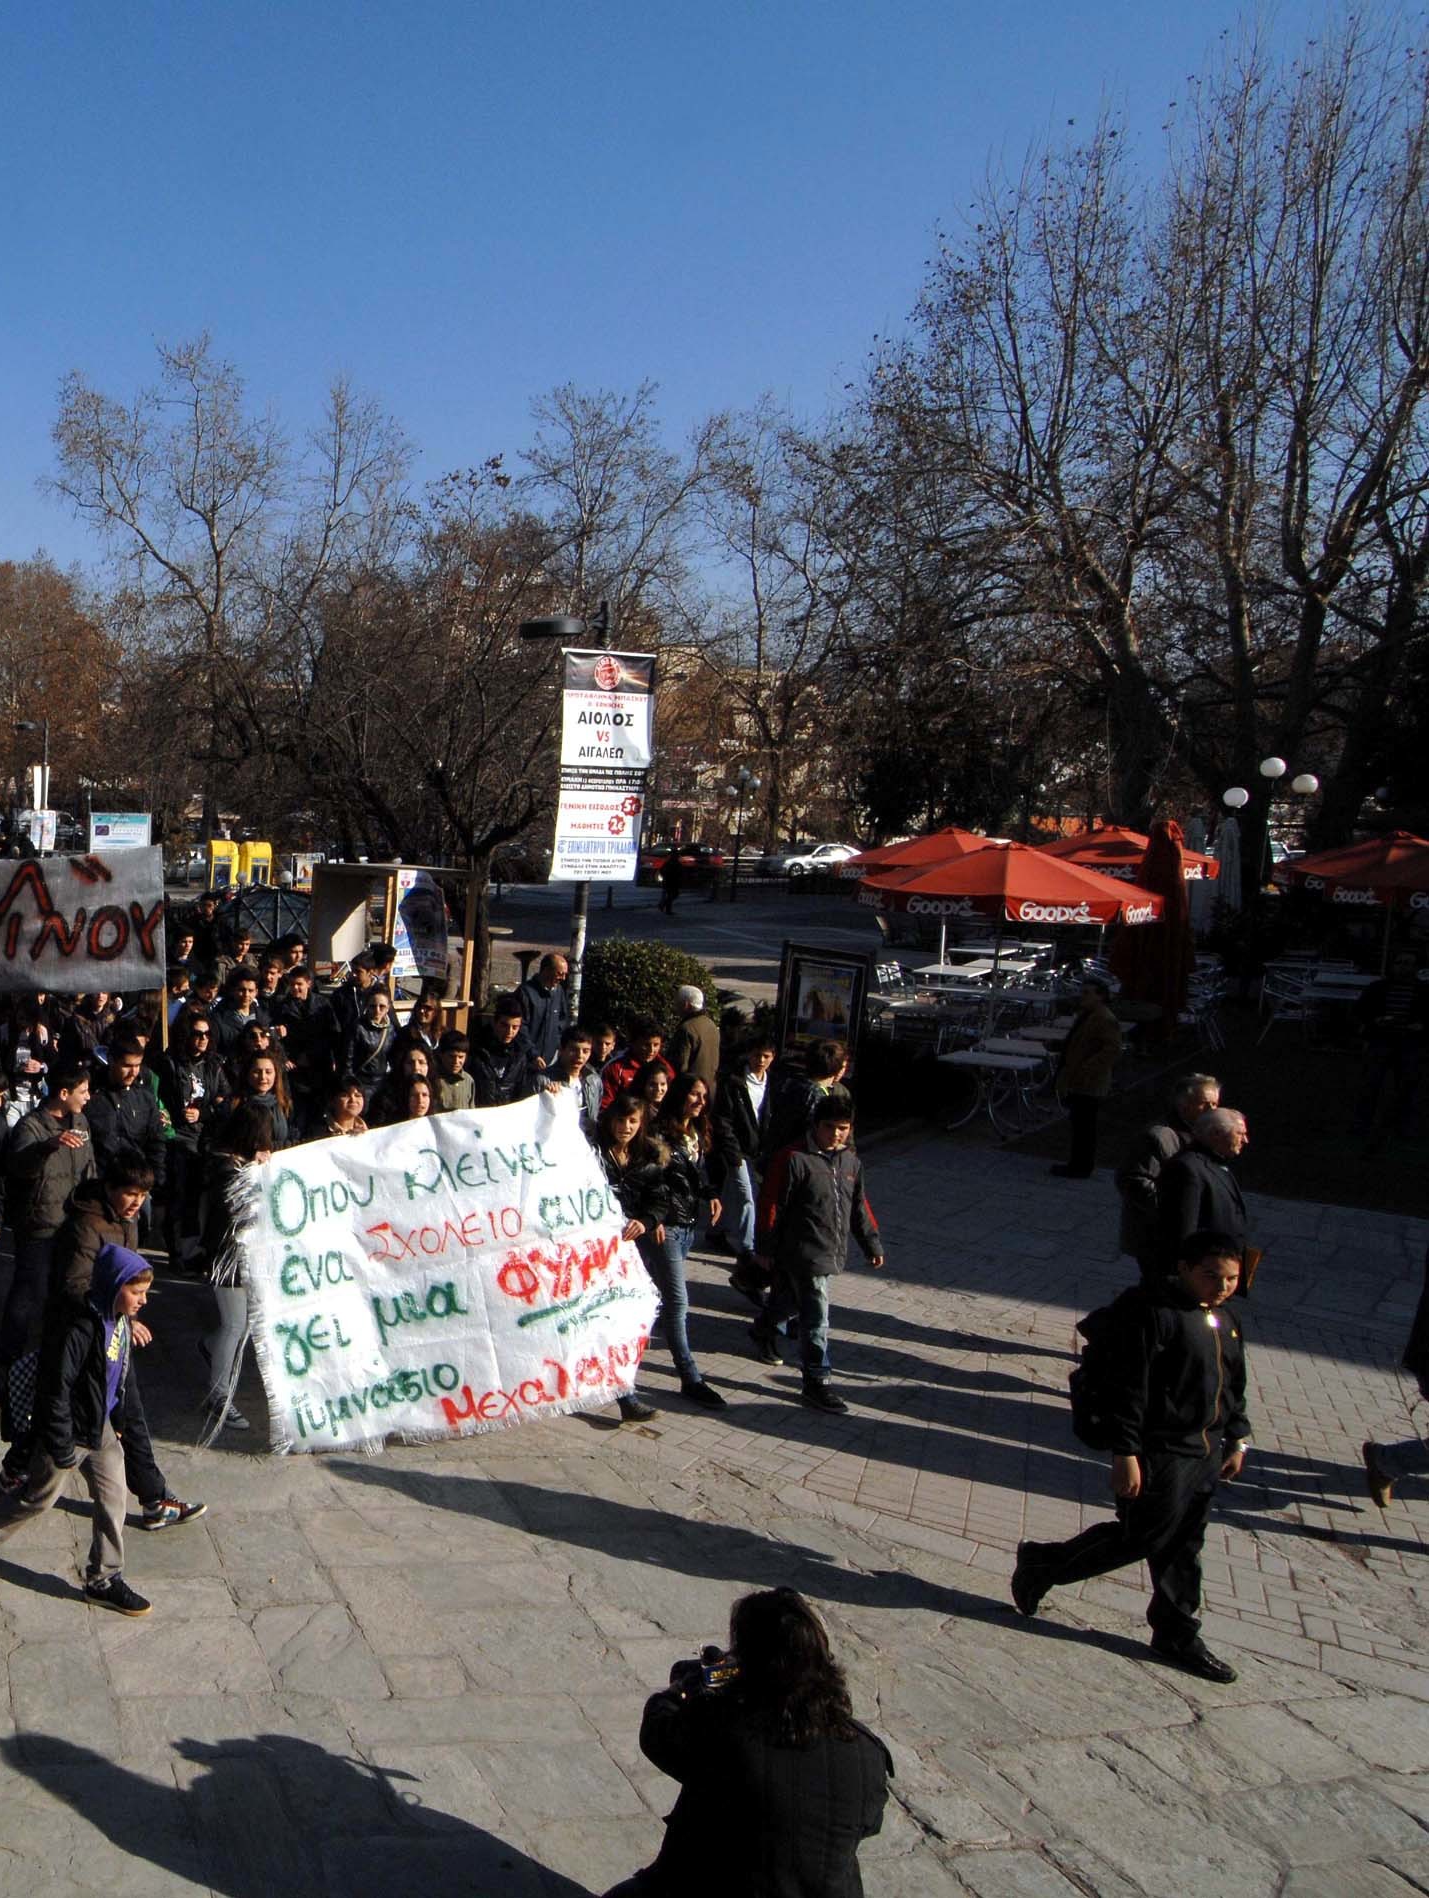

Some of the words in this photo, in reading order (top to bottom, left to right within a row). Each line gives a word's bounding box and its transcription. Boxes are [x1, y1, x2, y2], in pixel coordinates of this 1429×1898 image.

[577, 711, 634, 727] ΑΙΟΛΟΣ
[596, 730, 610, 742] VS
[578, 746, 624, 759] ΑΙΓΑΛΕΩ
[365, 1207, 523, 1262] ΣΧΟΛΕΙΟ
